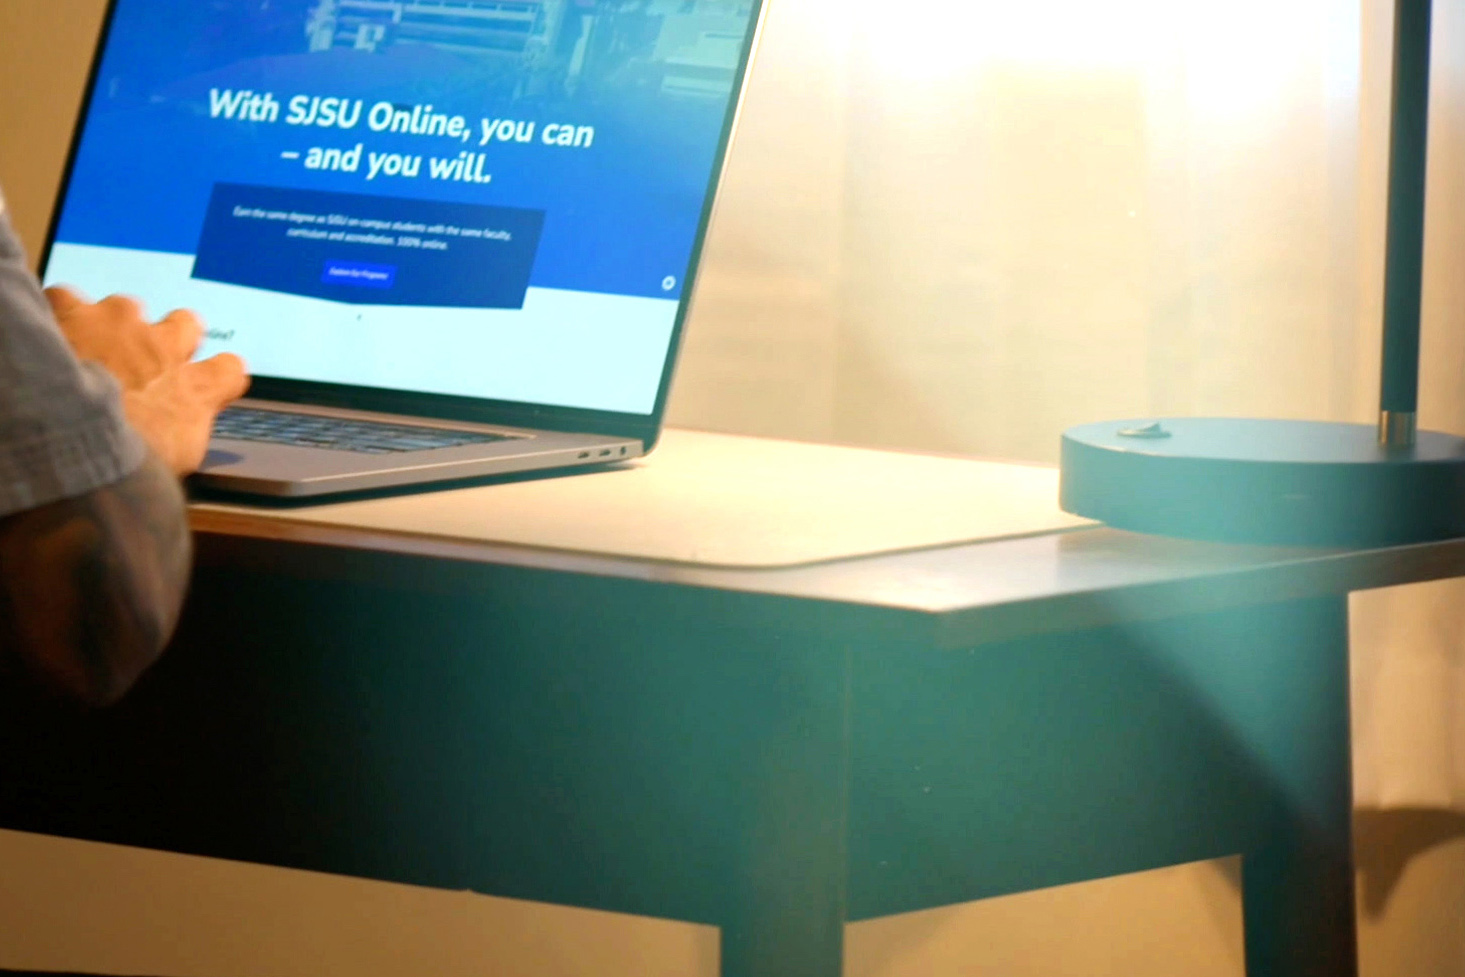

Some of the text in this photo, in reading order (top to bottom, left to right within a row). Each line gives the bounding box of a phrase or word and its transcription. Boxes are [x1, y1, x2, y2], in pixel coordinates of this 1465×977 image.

[210, 88, 595, 148] With SJSU Online, you can
[304, 142, 363, 173] and
[366, 151, 422, 181] you
[429, 150, 492, 184] will.
[251, 208, 265, 219] the
[267, 211, 287, 221] same
[288, 212, 315, 224] degree
[316, 215, 326, 224] as
[327, 214, 348, 226] SJSU
[392, 221, 426, 233] students
[426, 224, 445, 235] with
[445, 225, 460, 236] the
[460, 228, 482, 238] same
[286, 227, 328, 241] curriculum
[328, 231, 345, 242] and
